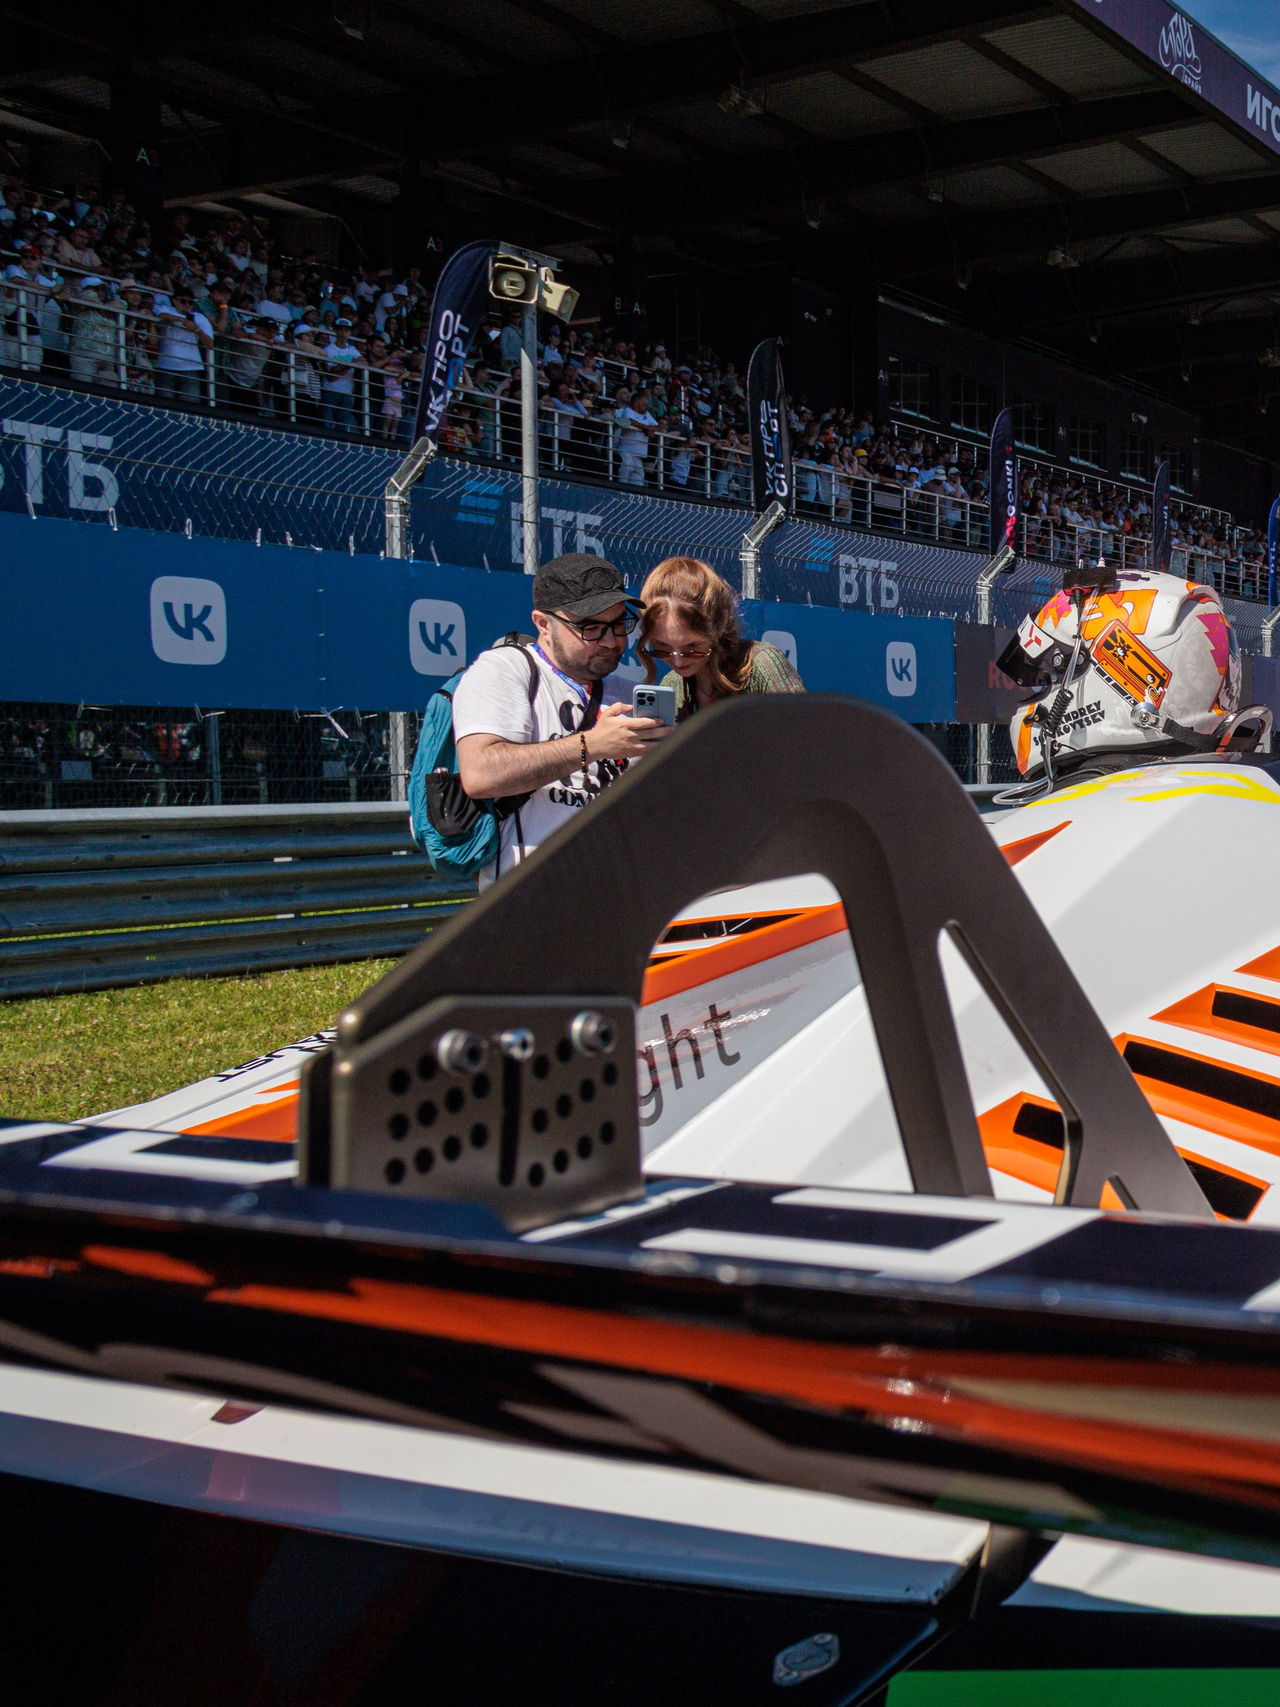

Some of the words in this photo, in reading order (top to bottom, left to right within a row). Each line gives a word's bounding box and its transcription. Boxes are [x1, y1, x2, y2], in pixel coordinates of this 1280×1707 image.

[0, 418, 119, 512] ТБ
[839, 553, 900, 608] ВТБ
[162, 601, 216, 642] VK
[418, 621, 458, 657] VK
[891, 658, 912, 681] VK
[1033, 709, 1106, 746] SKOVTSEV
[637, 1003, 742, 1128] ght
